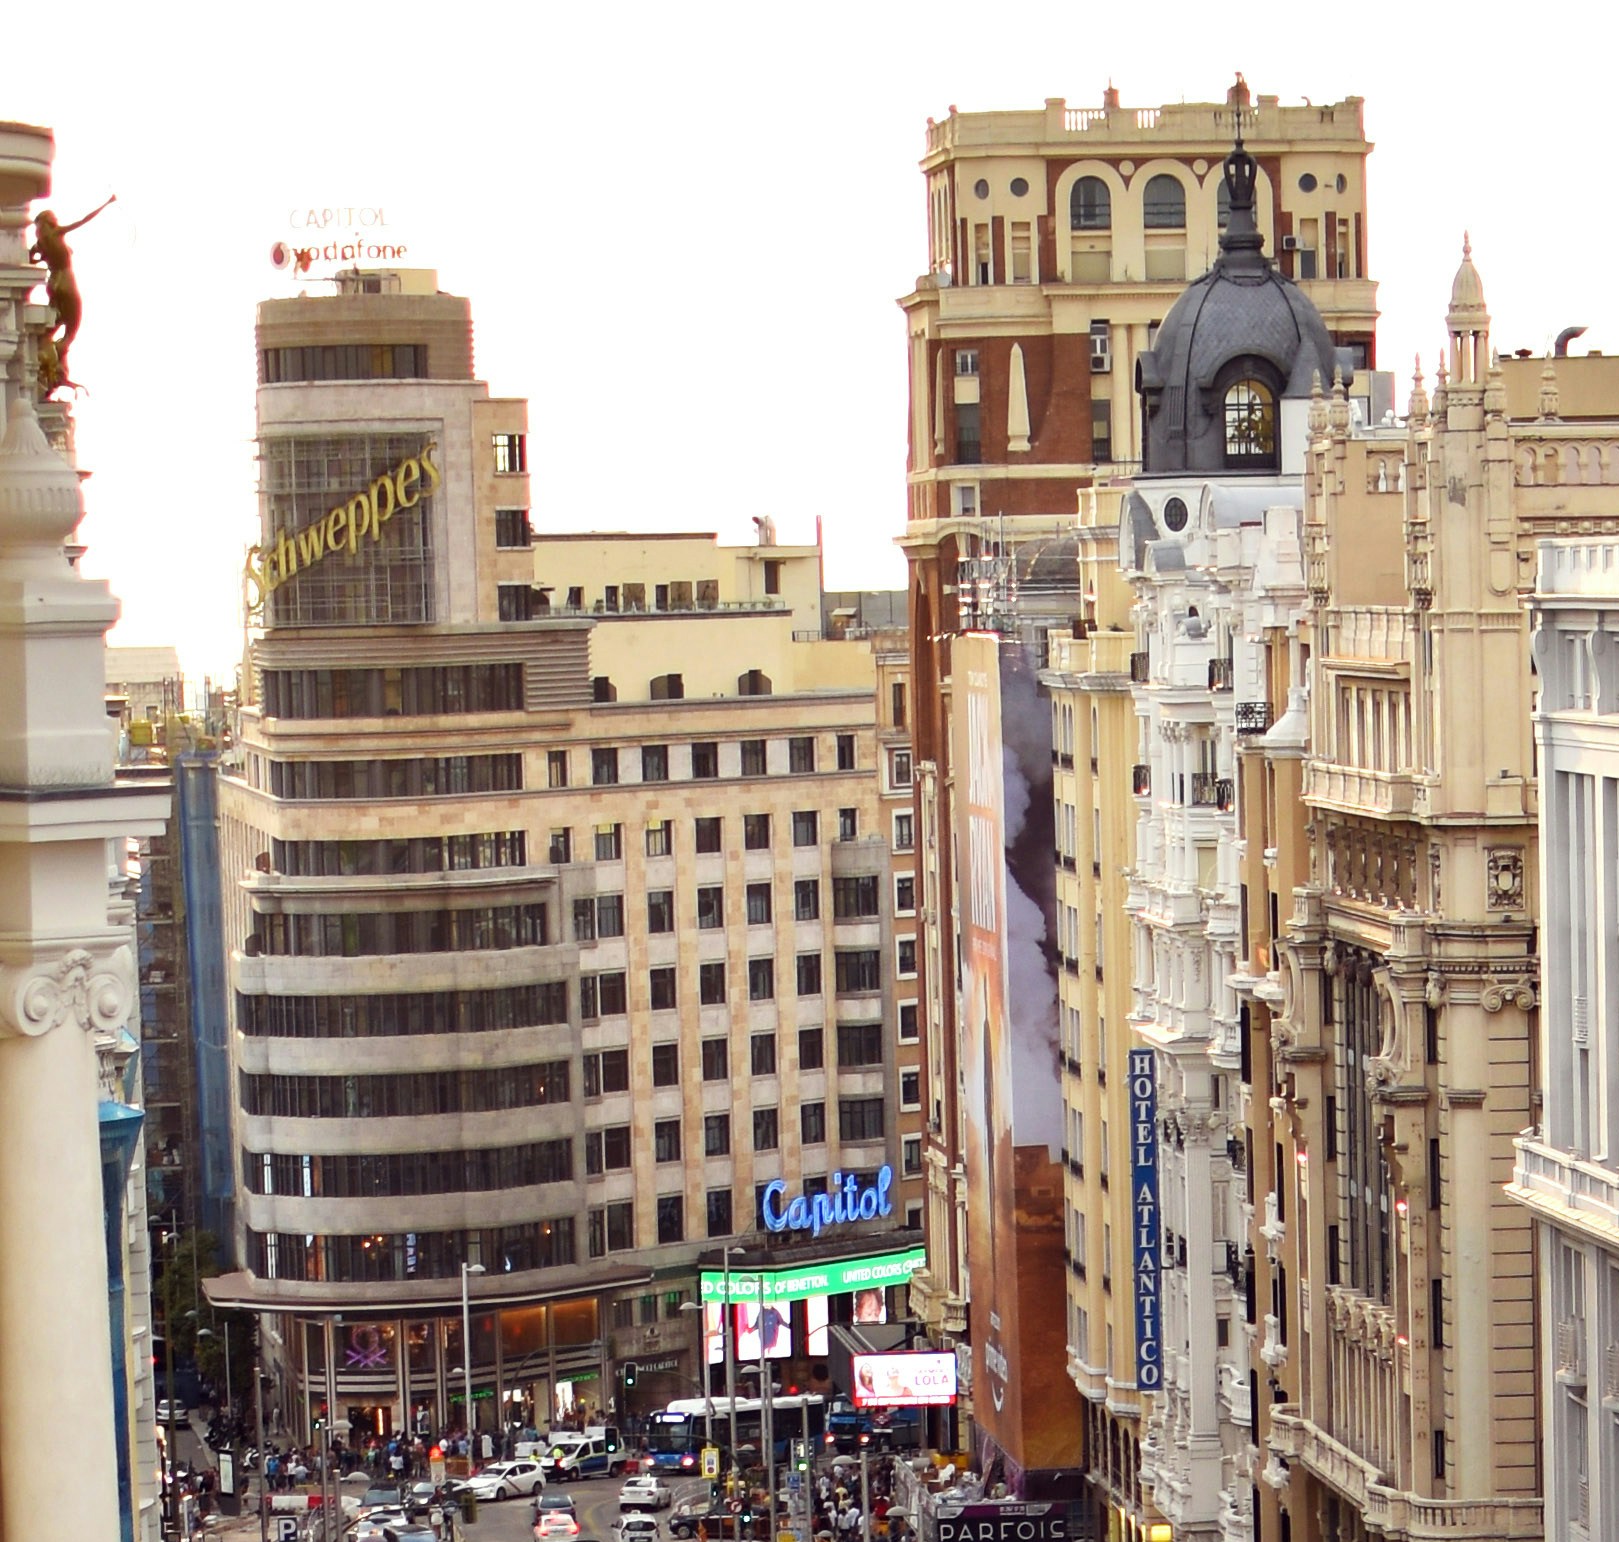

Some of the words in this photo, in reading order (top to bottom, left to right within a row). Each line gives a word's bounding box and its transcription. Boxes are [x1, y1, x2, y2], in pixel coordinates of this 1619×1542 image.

[290, 207, 389, 228] CAPITOL
[293, 239, 407, 260] vodafone
[246, 441, 441, 609] Schweppes
[1131, 1055, 1153, 1166] HOTEL
[763, 1165, 893, 1237] Capitol
[1138, 1182, 1160, 1385] ATLANTICO
[914, 1375, 949, 1386] LOLA
[279, 1519, 297, 1542] P
[940, 1520, 1065, 1541] PARFOIS
